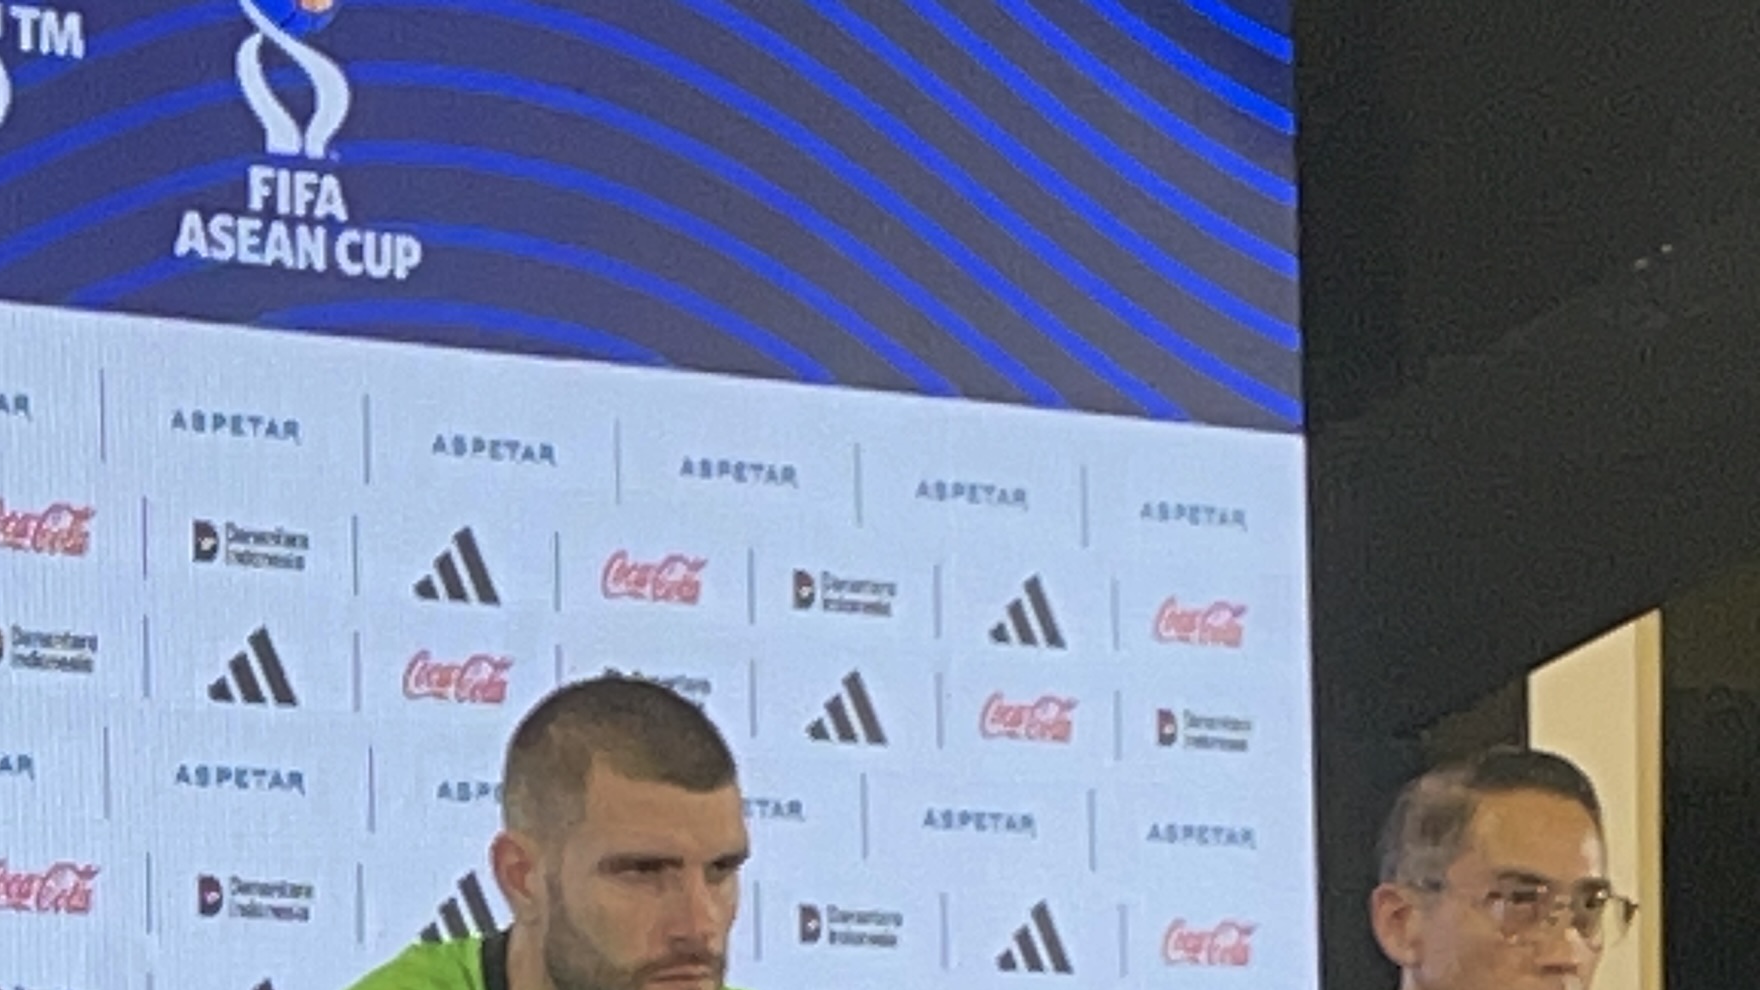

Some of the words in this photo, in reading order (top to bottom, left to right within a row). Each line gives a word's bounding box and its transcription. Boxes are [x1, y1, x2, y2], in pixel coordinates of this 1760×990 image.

[247, 164, 348, 222] FIFA
[173, 210, 327, 272] ASEAN
[335, 228, 422, 280] CUP
[172, 410, 299, 445] ASPETAR
[432, 435, 555, 466] ASPETAR
[680, 457, 798, 488] ASPETAR
[915, 480, 1028, 511] ASPETAR
[1140, 501, 1247, 532] ASPETAR
[176, 765, 305, 796] ASPETAR
[923, 809, 1036, 837] ASPETAR
